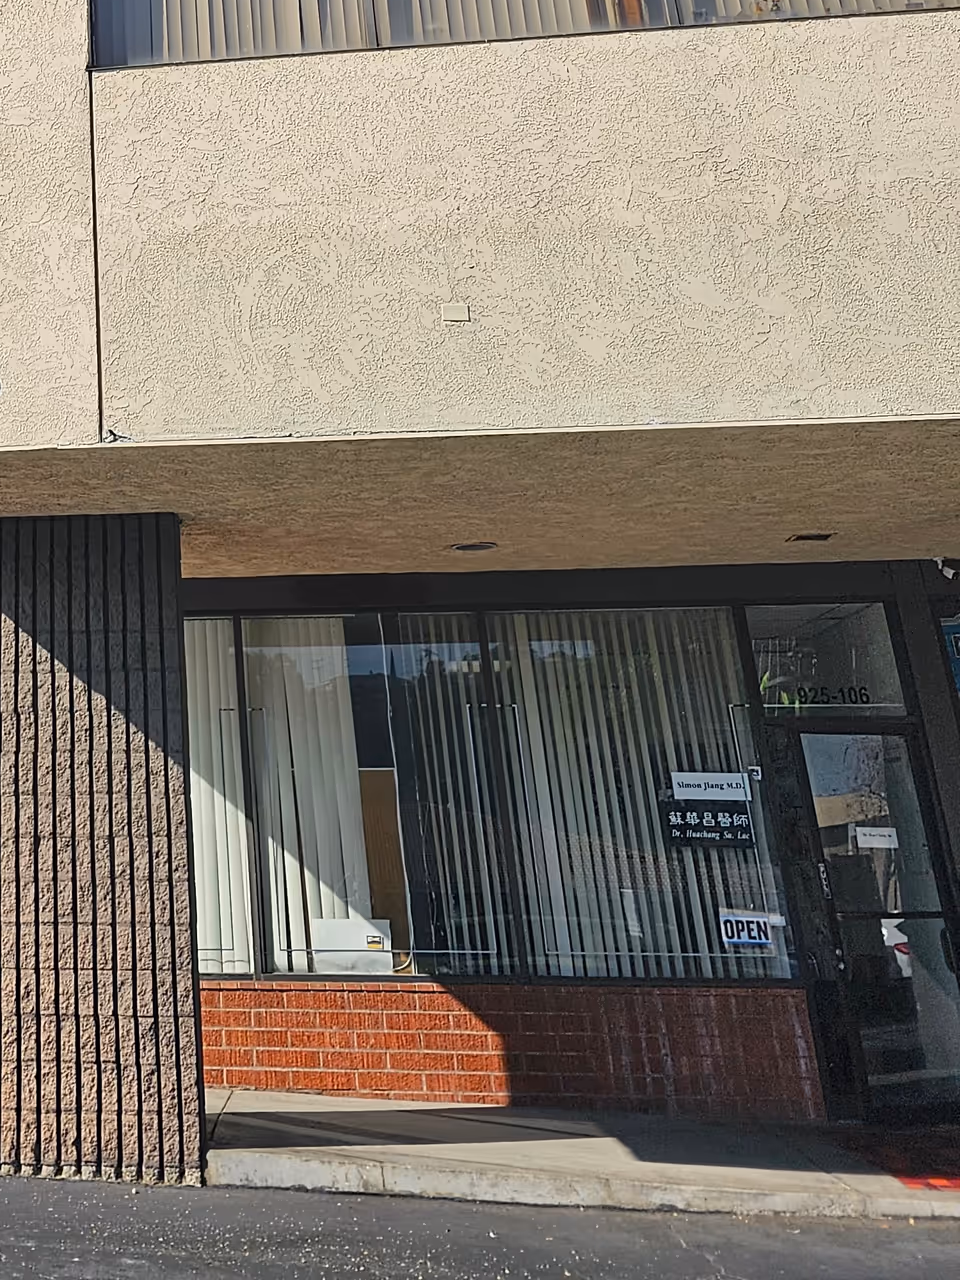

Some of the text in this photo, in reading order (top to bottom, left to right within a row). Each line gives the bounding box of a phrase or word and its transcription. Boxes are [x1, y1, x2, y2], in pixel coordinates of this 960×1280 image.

[797, 686, 870, 704] 925-106
[676, 781, 702, 789] Simon
[703, 781, 725, 791] Jiang
[668, 811, 748, 827] 蘇華昌醫師
[672, 829, 683, 837] Dr.
[723, 919, 770, 940] OPEN
